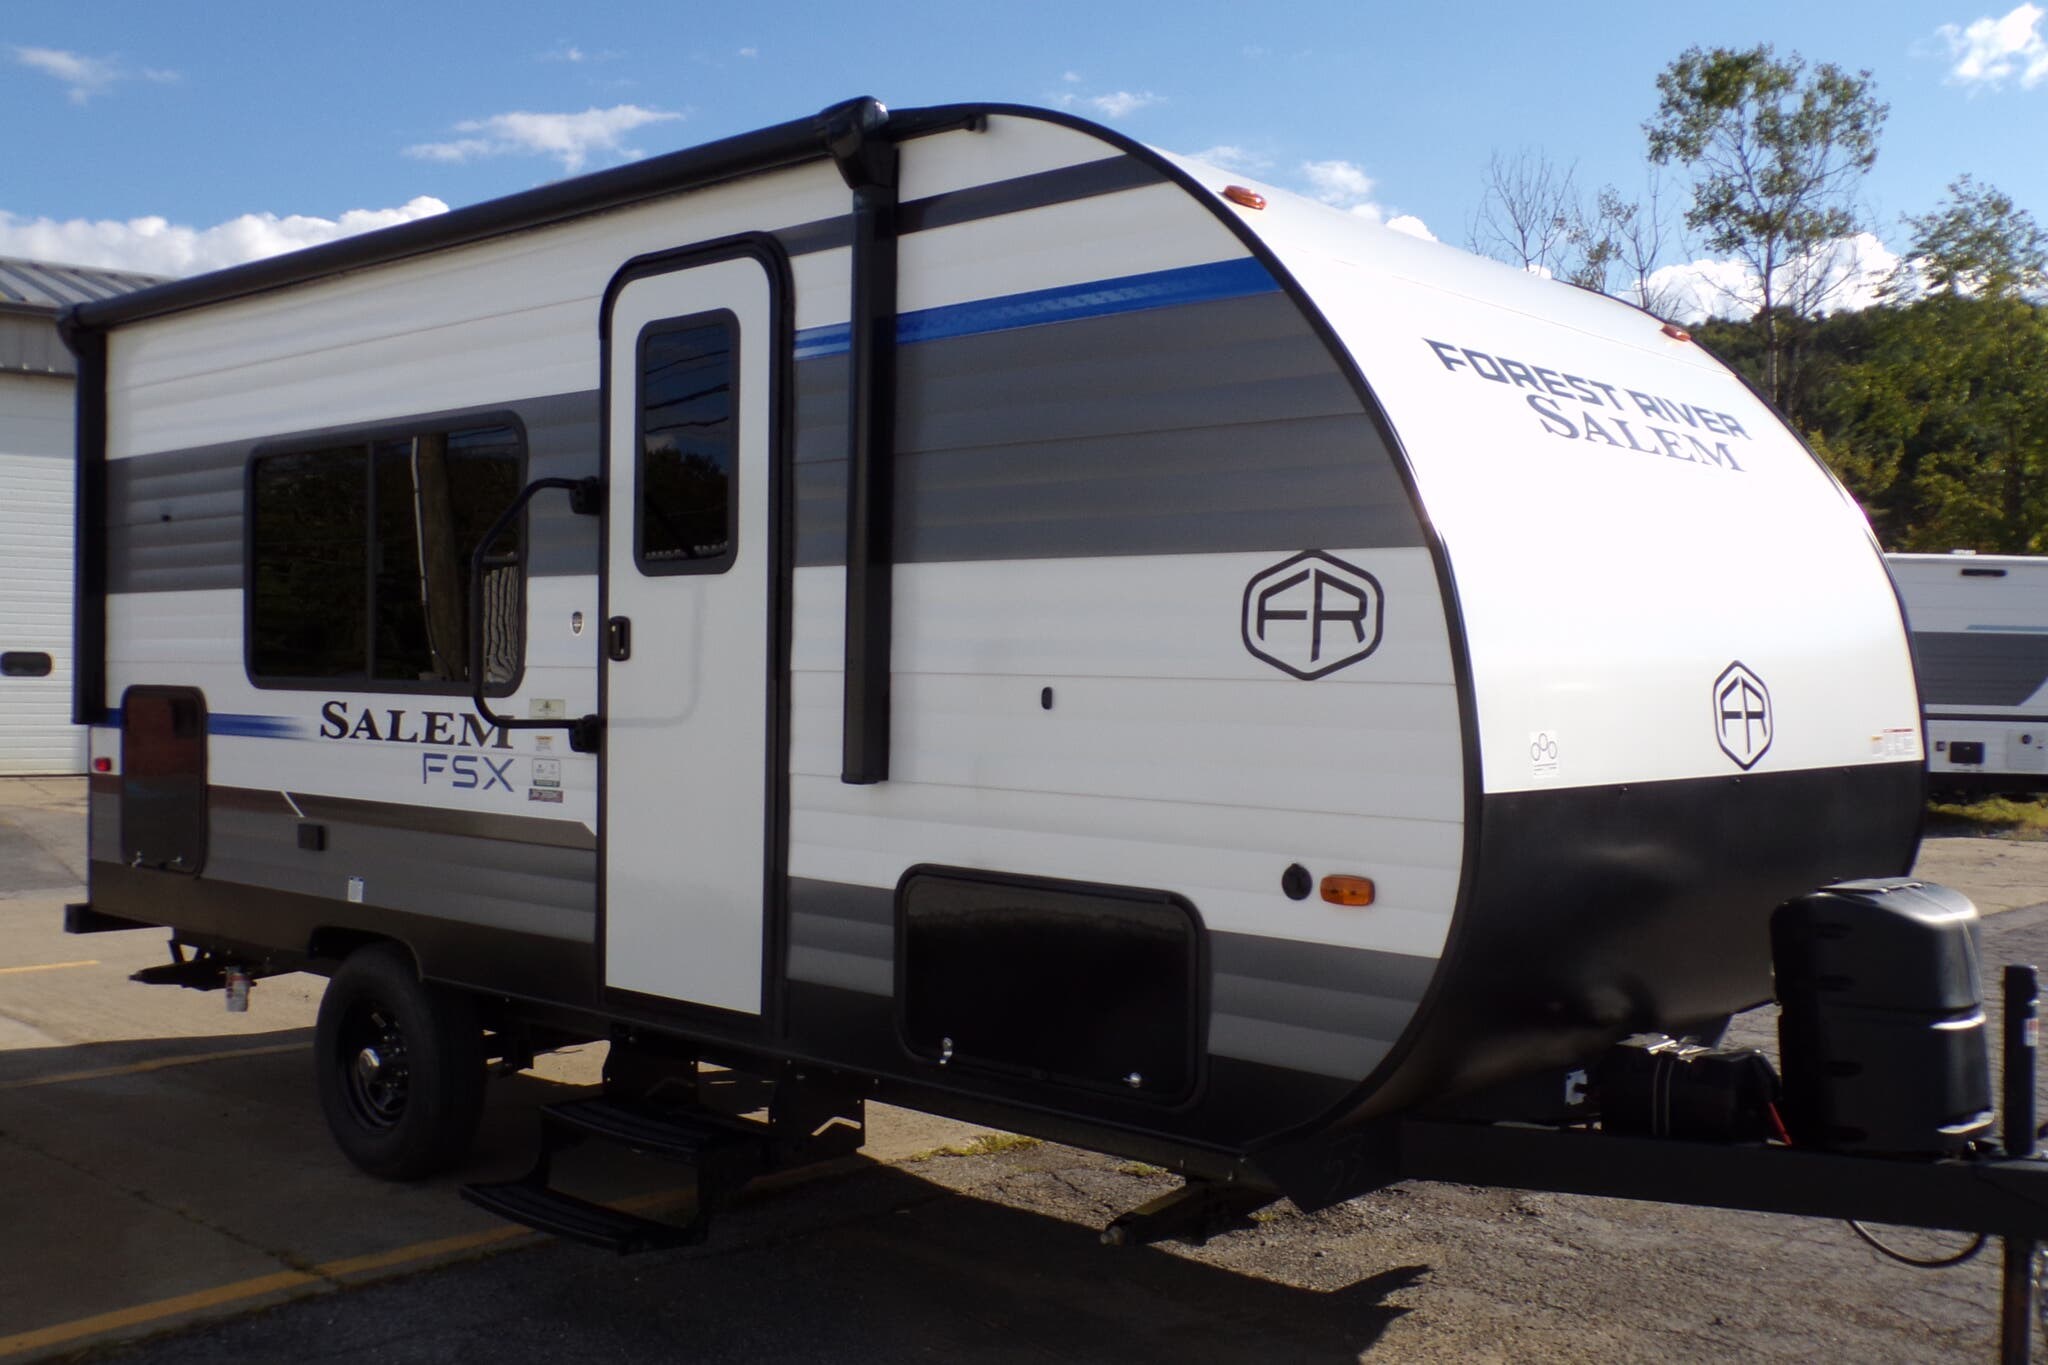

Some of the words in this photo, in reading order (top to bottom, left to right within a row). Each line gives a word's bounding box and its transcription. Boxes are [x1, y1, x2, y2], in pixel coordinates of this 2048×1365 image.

[1422, 337, 1624, 411] FOREST
[1622, 388, 1753, 441] RIVER
[1526, 393, 1748, 473] SALEM
[319, 700, 515, 750] SALEM
[422, 752, 515, 793] FSX
